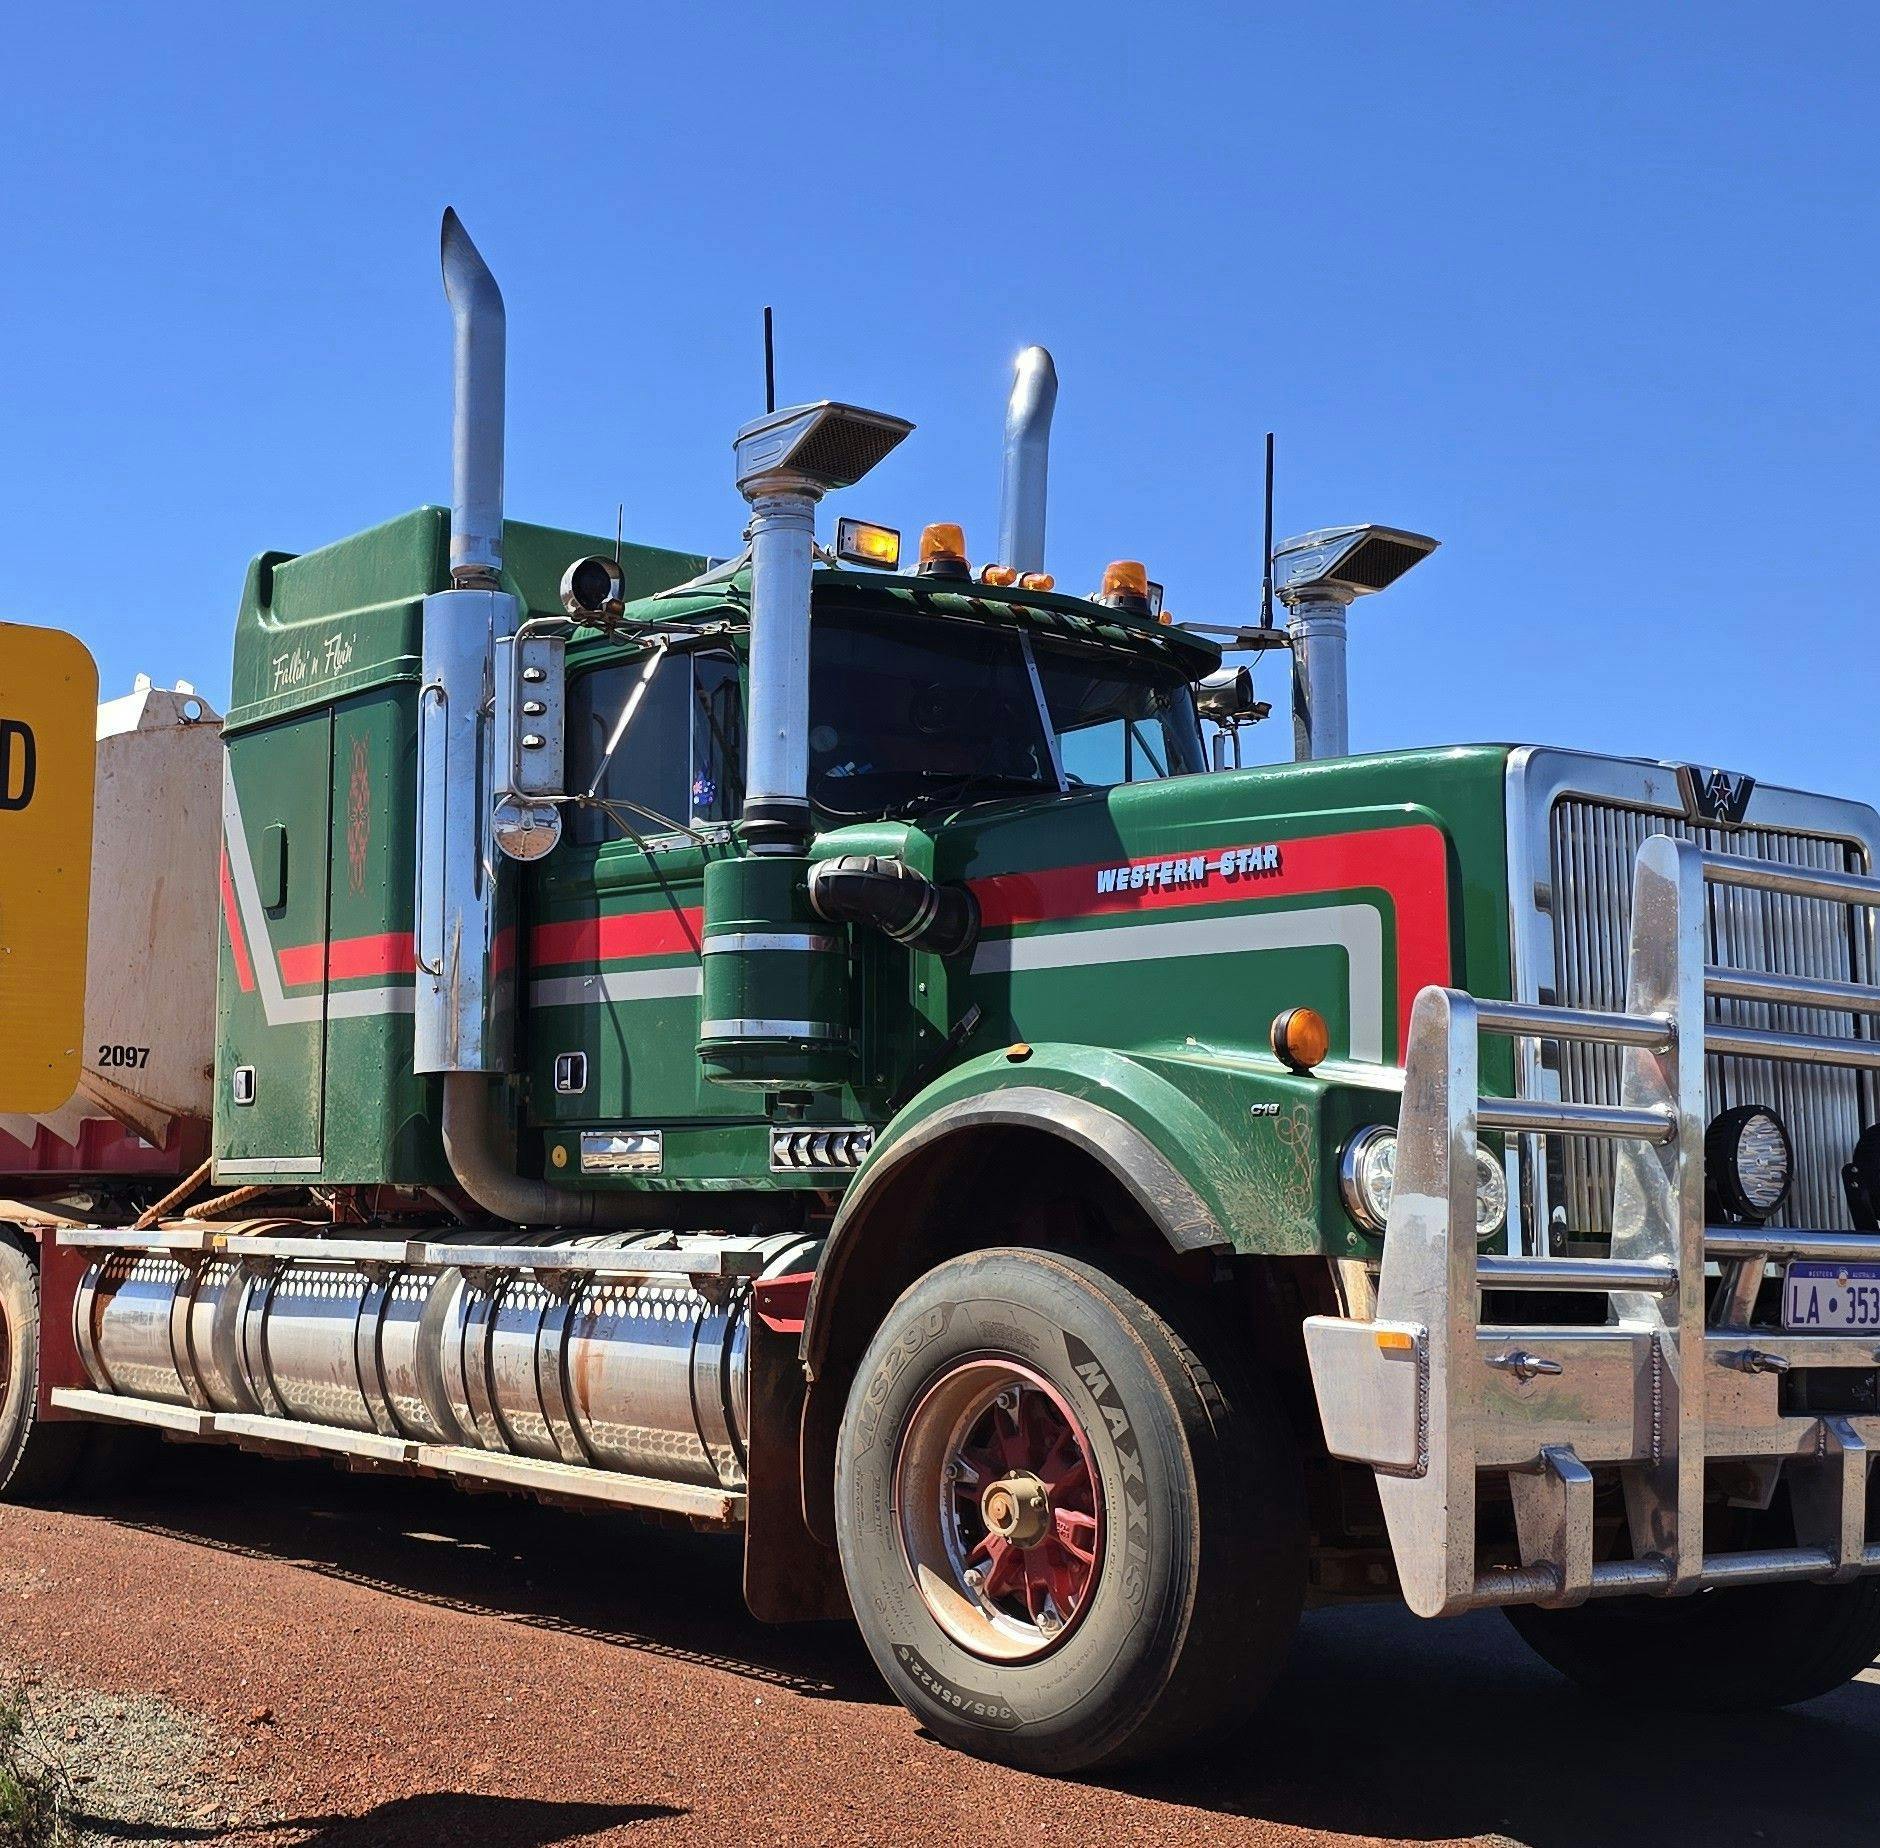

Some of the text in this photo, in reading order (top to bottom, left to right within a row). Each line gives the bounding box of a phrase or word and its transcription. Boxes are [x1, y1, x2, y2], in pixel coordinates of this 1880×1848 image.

[98, 1045, 150, 1069] 2097
[1074, 1361, 1148, 1607] MAXXIS
[898, 1646, 1012, 1720] 385/65R22.5
